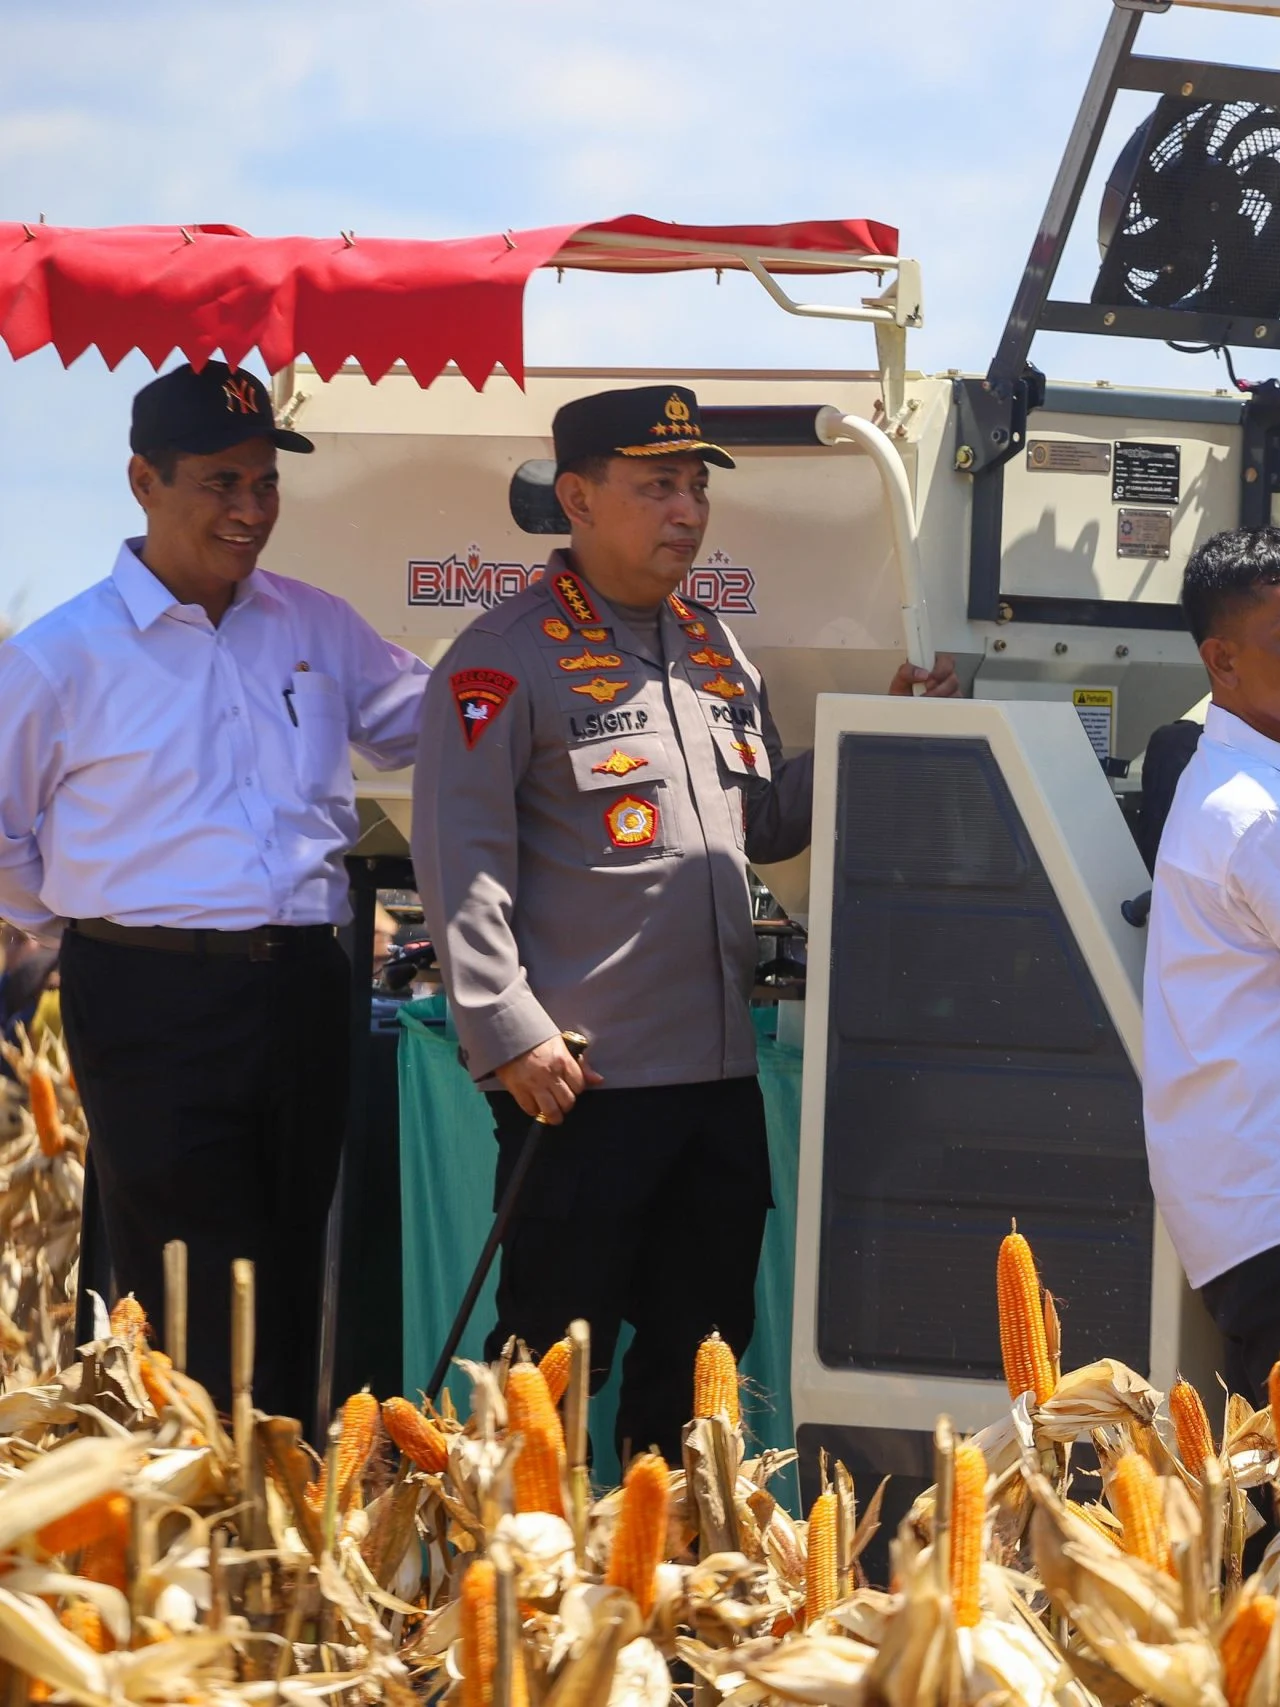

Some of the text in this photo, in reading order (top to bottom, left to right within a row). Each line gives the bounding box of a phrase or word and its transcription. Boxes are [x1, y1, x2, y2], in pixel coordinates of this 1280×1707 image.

[222, 379, 259, 414] NY
[408, 553, 546, 610] BIMO
[710, 704, 757, 730] POLRI
